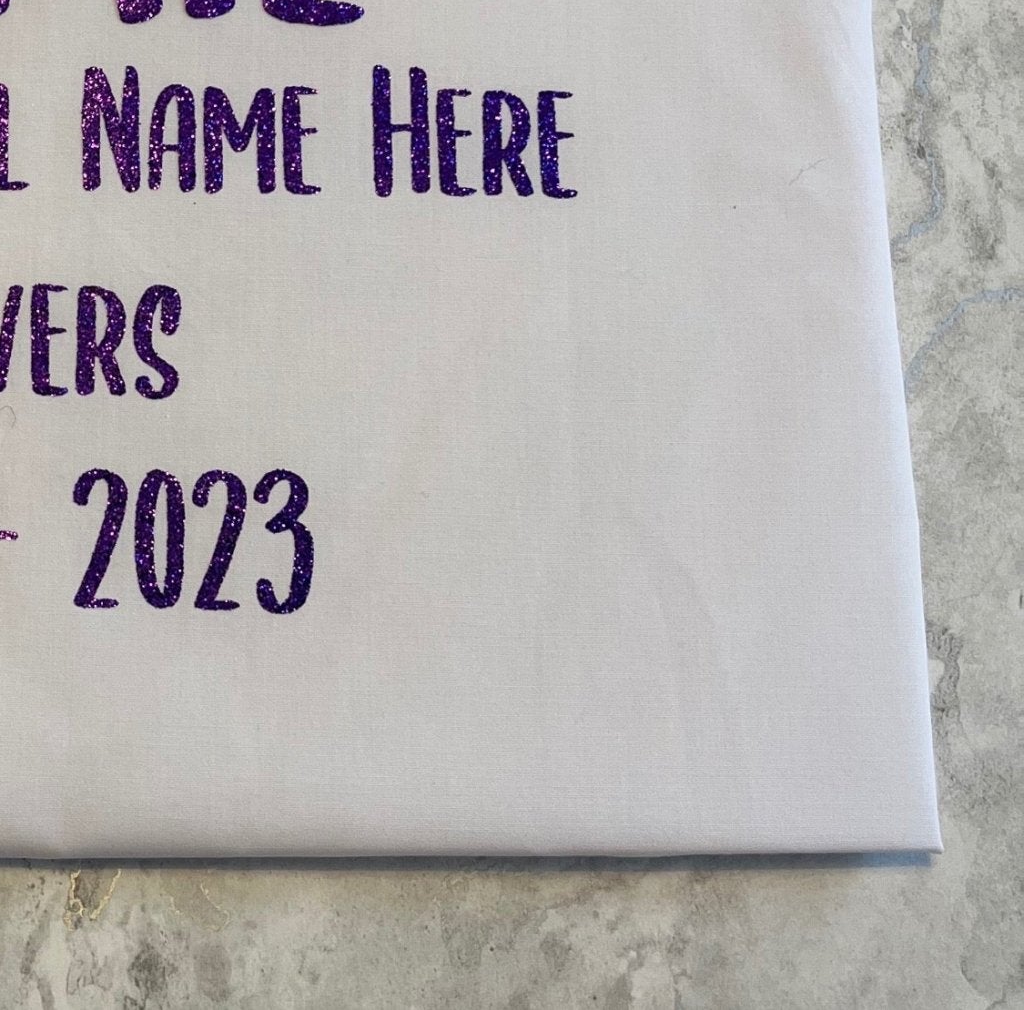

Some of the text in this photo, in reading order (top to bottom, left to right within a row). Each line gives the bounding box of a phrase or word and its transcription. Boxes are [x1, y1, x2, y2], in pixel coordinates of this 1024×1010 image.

[81, 65, 322, 195] NAME
[372, 64, 578, 199] HERE
[73, 468, 315, 615] 2023
